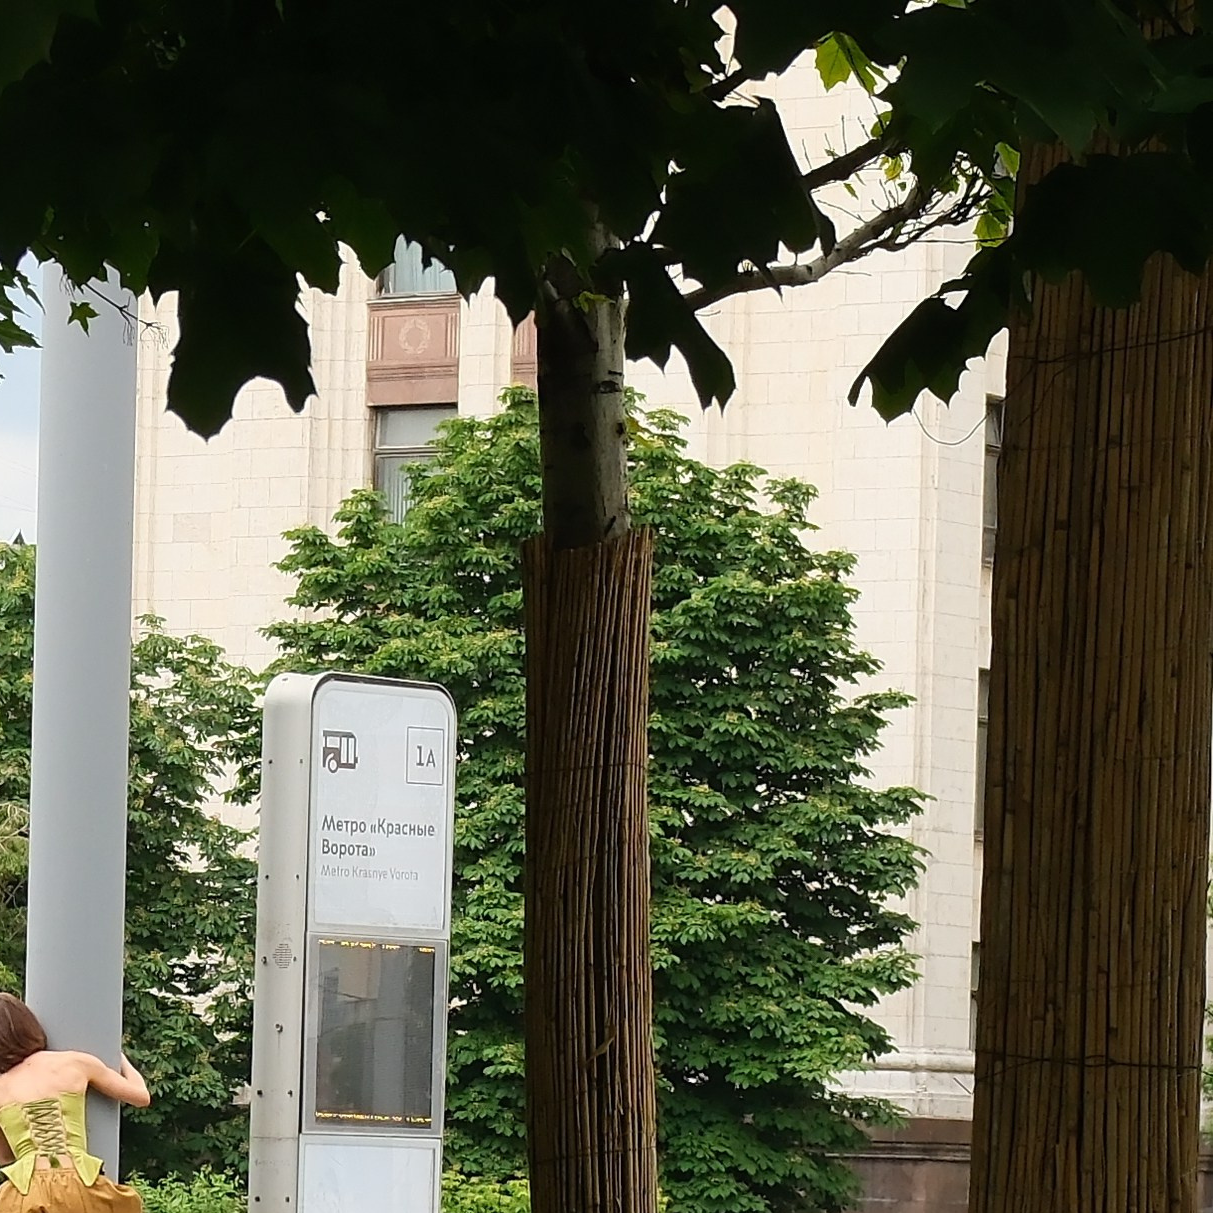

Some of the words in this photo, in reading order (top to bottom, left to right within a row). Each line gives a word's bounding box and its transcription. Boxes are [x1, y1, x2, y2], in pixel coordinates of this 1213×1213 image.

[321, 815, 367, 836] Метро
[370, 818, 436, 838] «Красные
[321, 838, 377, 859] Ворота»
[320, 864, 350, 878] Metro
[351, 866, 389, 881] Krasnye
[389, 867, 419, 881] Vorota
